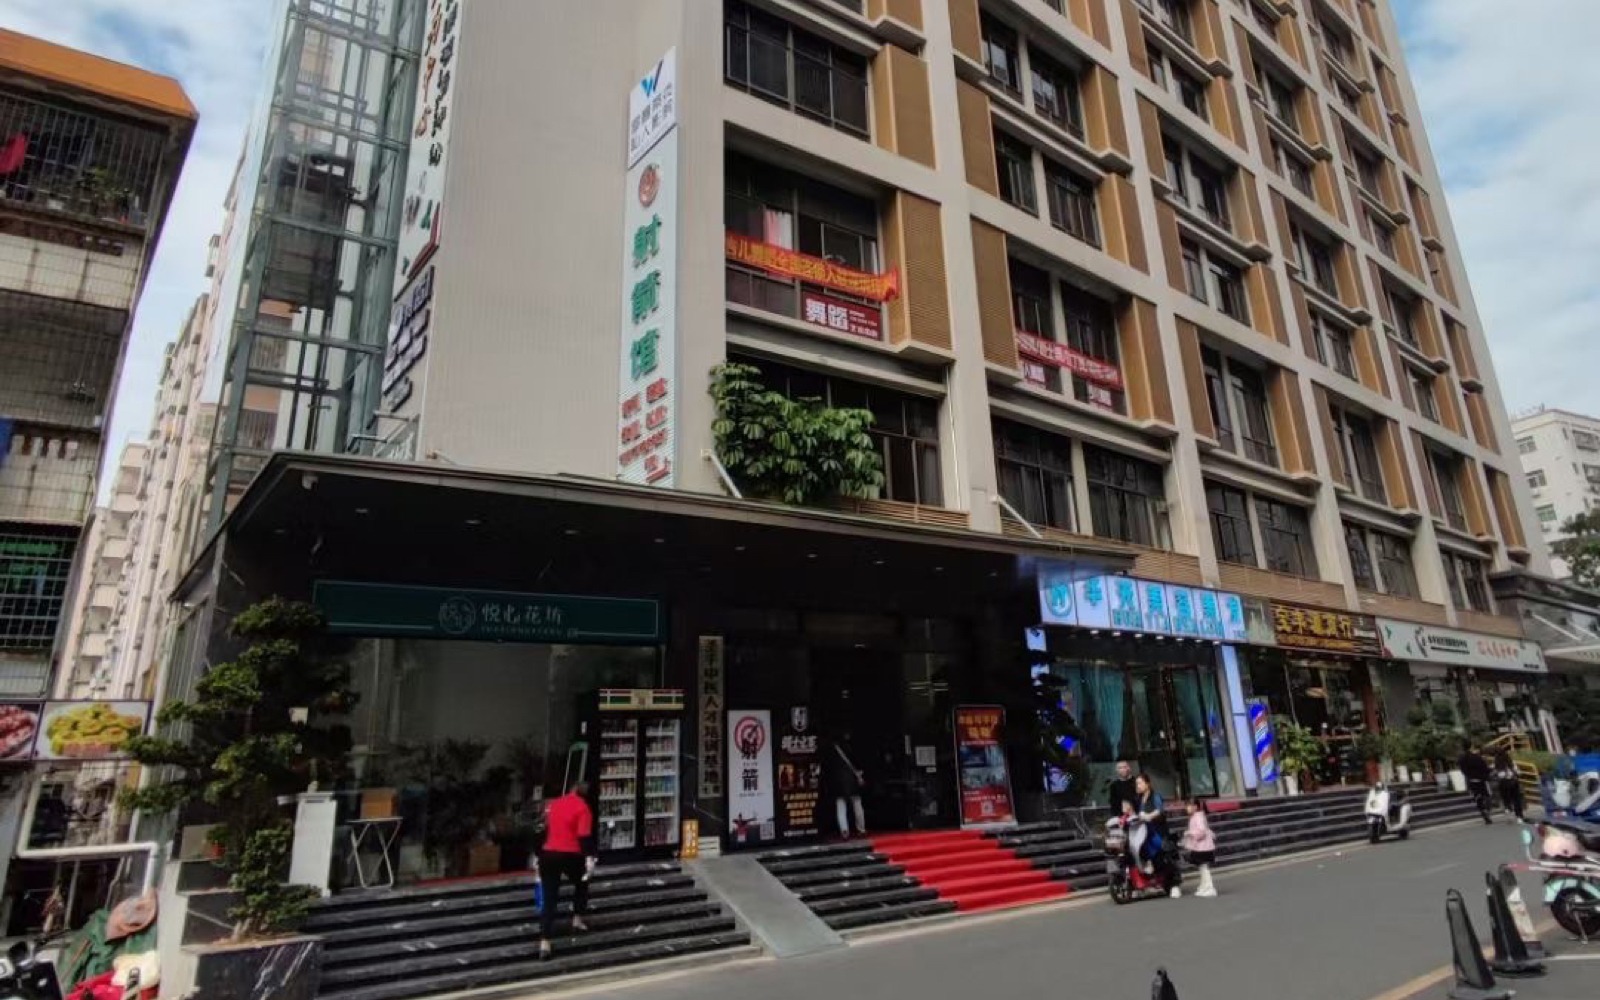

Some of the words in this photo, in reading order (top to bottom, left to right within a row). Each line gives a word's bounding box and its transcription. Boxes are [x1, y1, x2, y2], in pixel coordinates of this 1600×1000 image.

[631, 214, 662, 381] 射箭馆
[742, 738, 759, 791] 射箭
